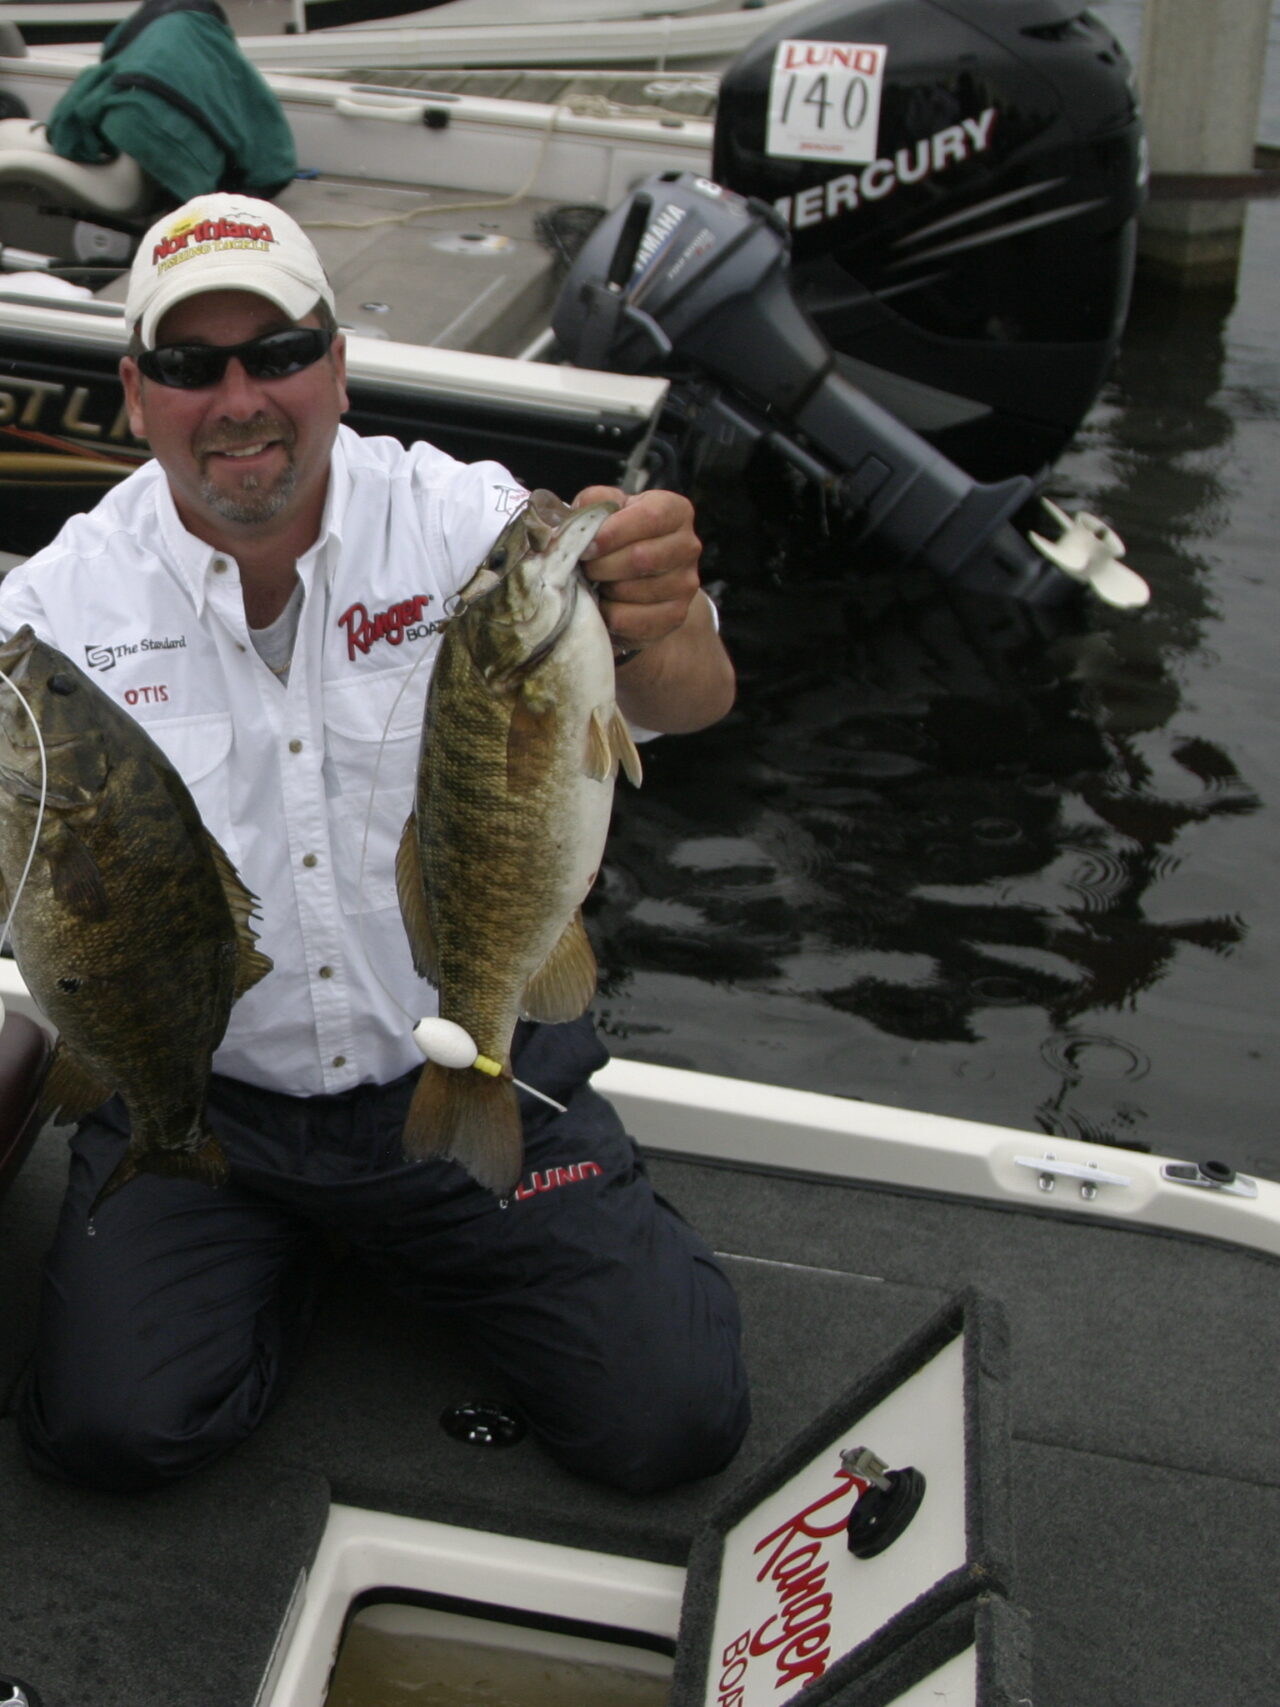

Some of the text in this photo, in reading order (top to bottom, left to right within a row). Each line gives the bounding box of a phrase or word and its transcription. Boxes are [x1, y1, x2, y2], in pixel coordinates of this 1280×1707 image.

[784, 46, 879, 76] LUND
[781, 73, 868, 130] 140
[153, 217, 274, 266] Northland
[157, 238, 270, 276] FISHING TACKLE
[115, 636, 186, 658] The Standard
[337, 595, 430, 662] Ranger
[124, 684, 169, 706] OTIS
[515, 1161, 604, 1201] LUND
[753, 1467, 870, 1690] Ranger
